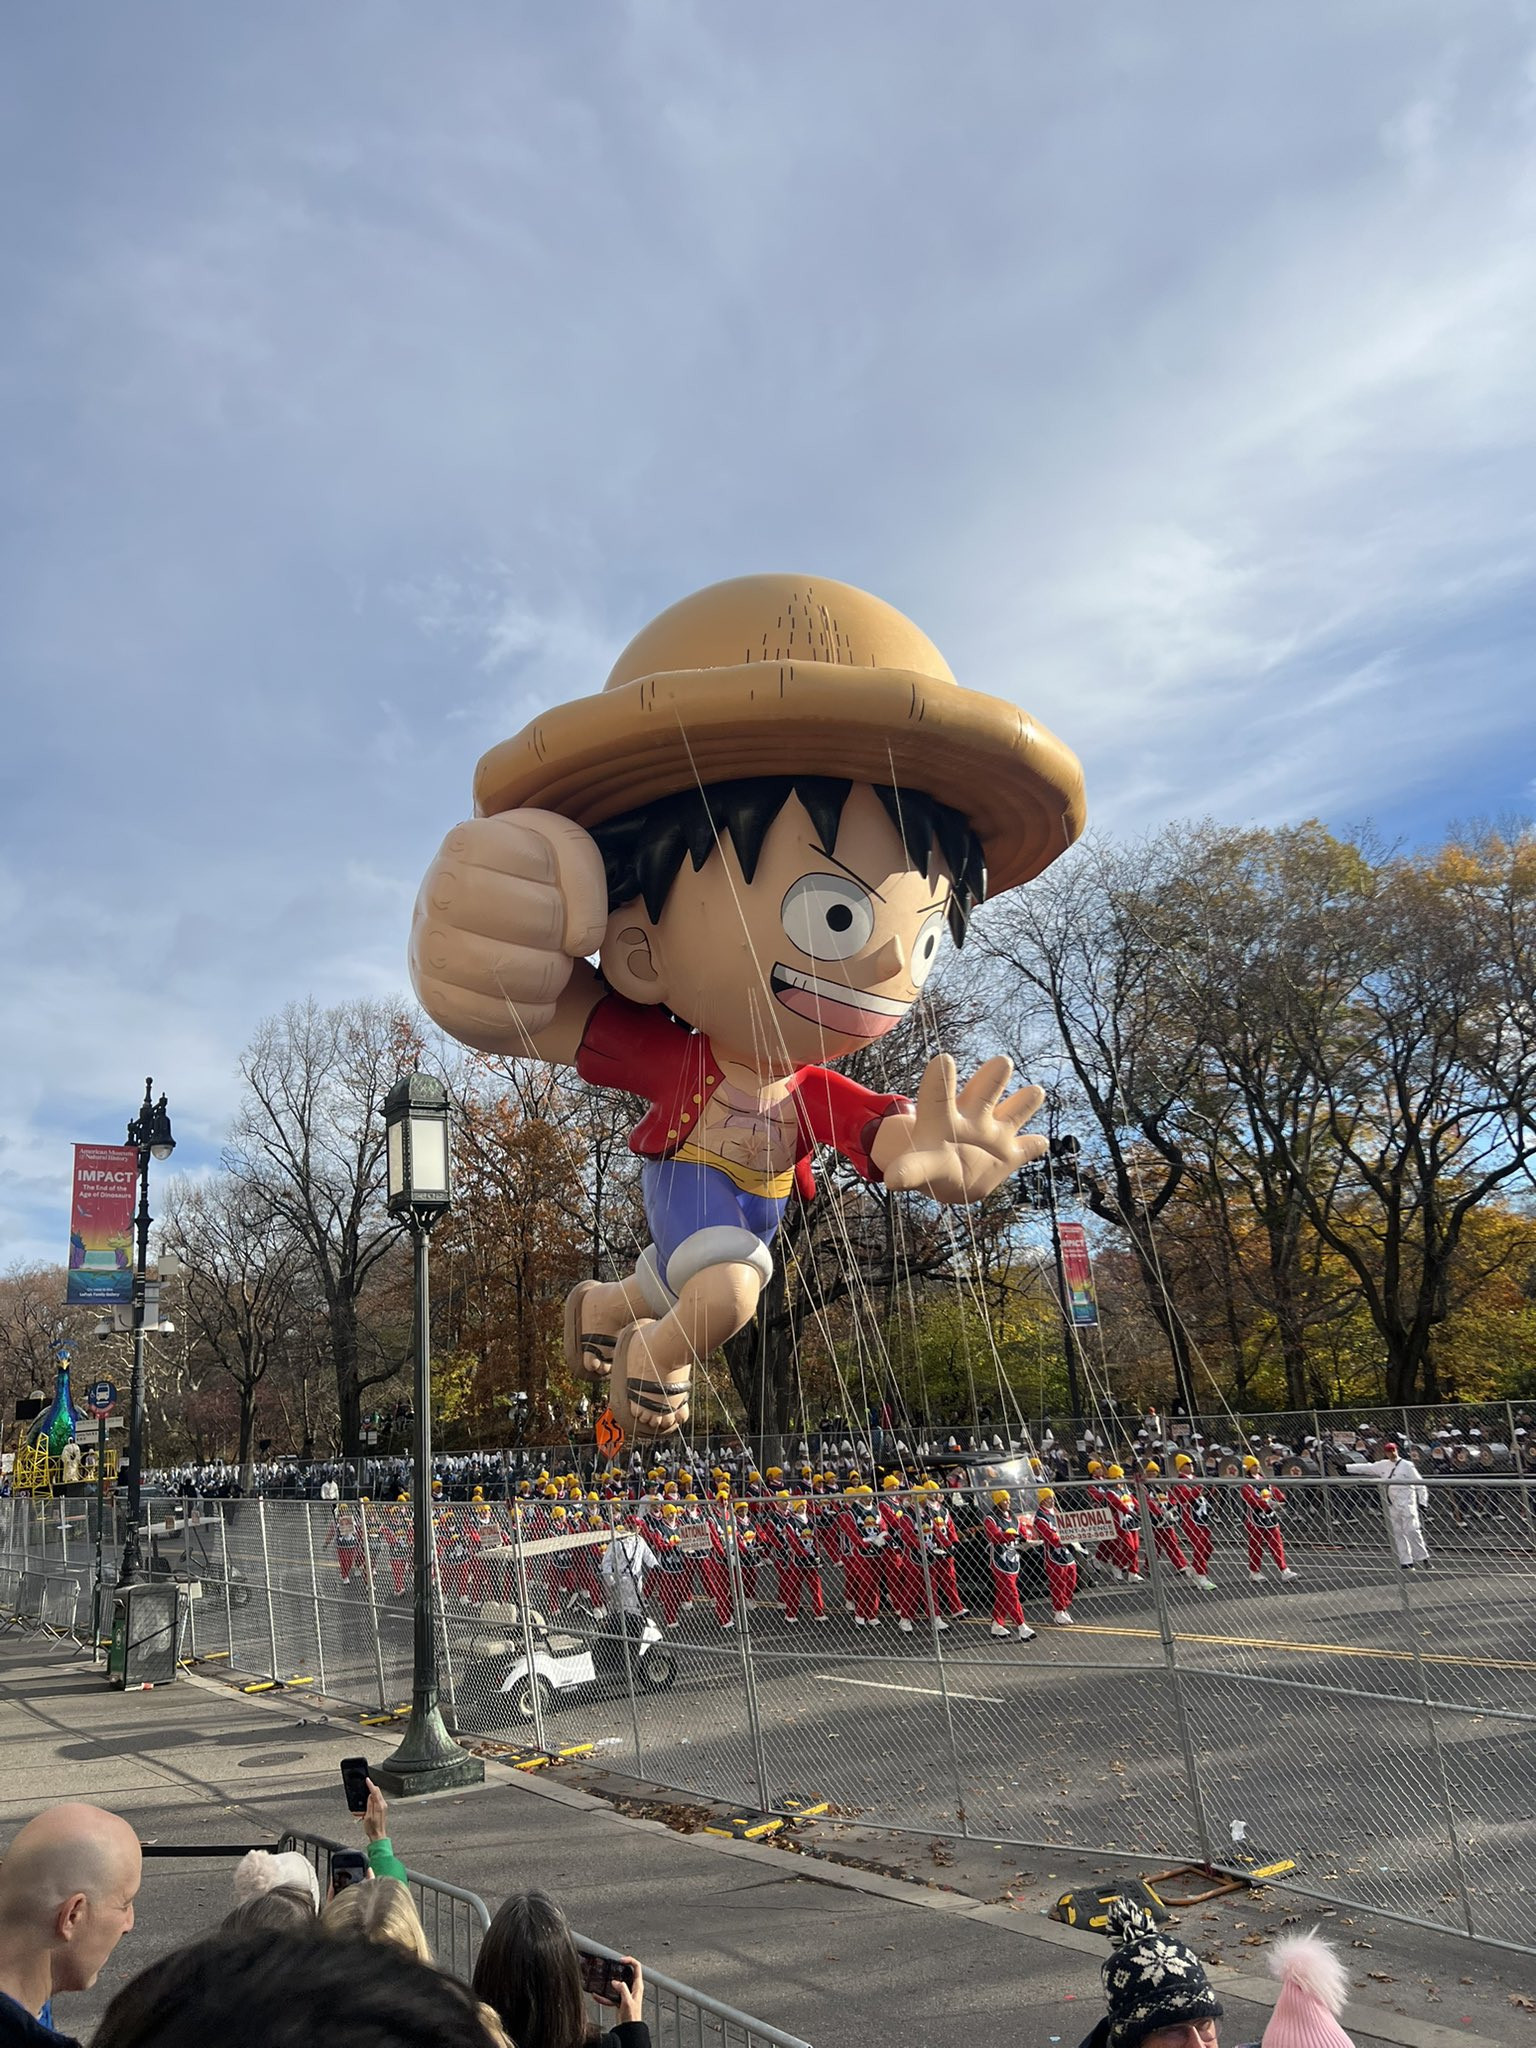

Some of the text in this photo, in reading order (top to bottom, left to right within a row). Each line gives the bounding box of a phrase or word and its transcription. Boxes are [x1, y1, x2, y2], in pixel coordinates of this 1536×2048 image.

[78, 1170, 133, 1183] IMPACT
[1056, 1510, 1112, 1529] NATIONAL
[1059, 1525, 1113, 1534] RENT-A-FENCE
